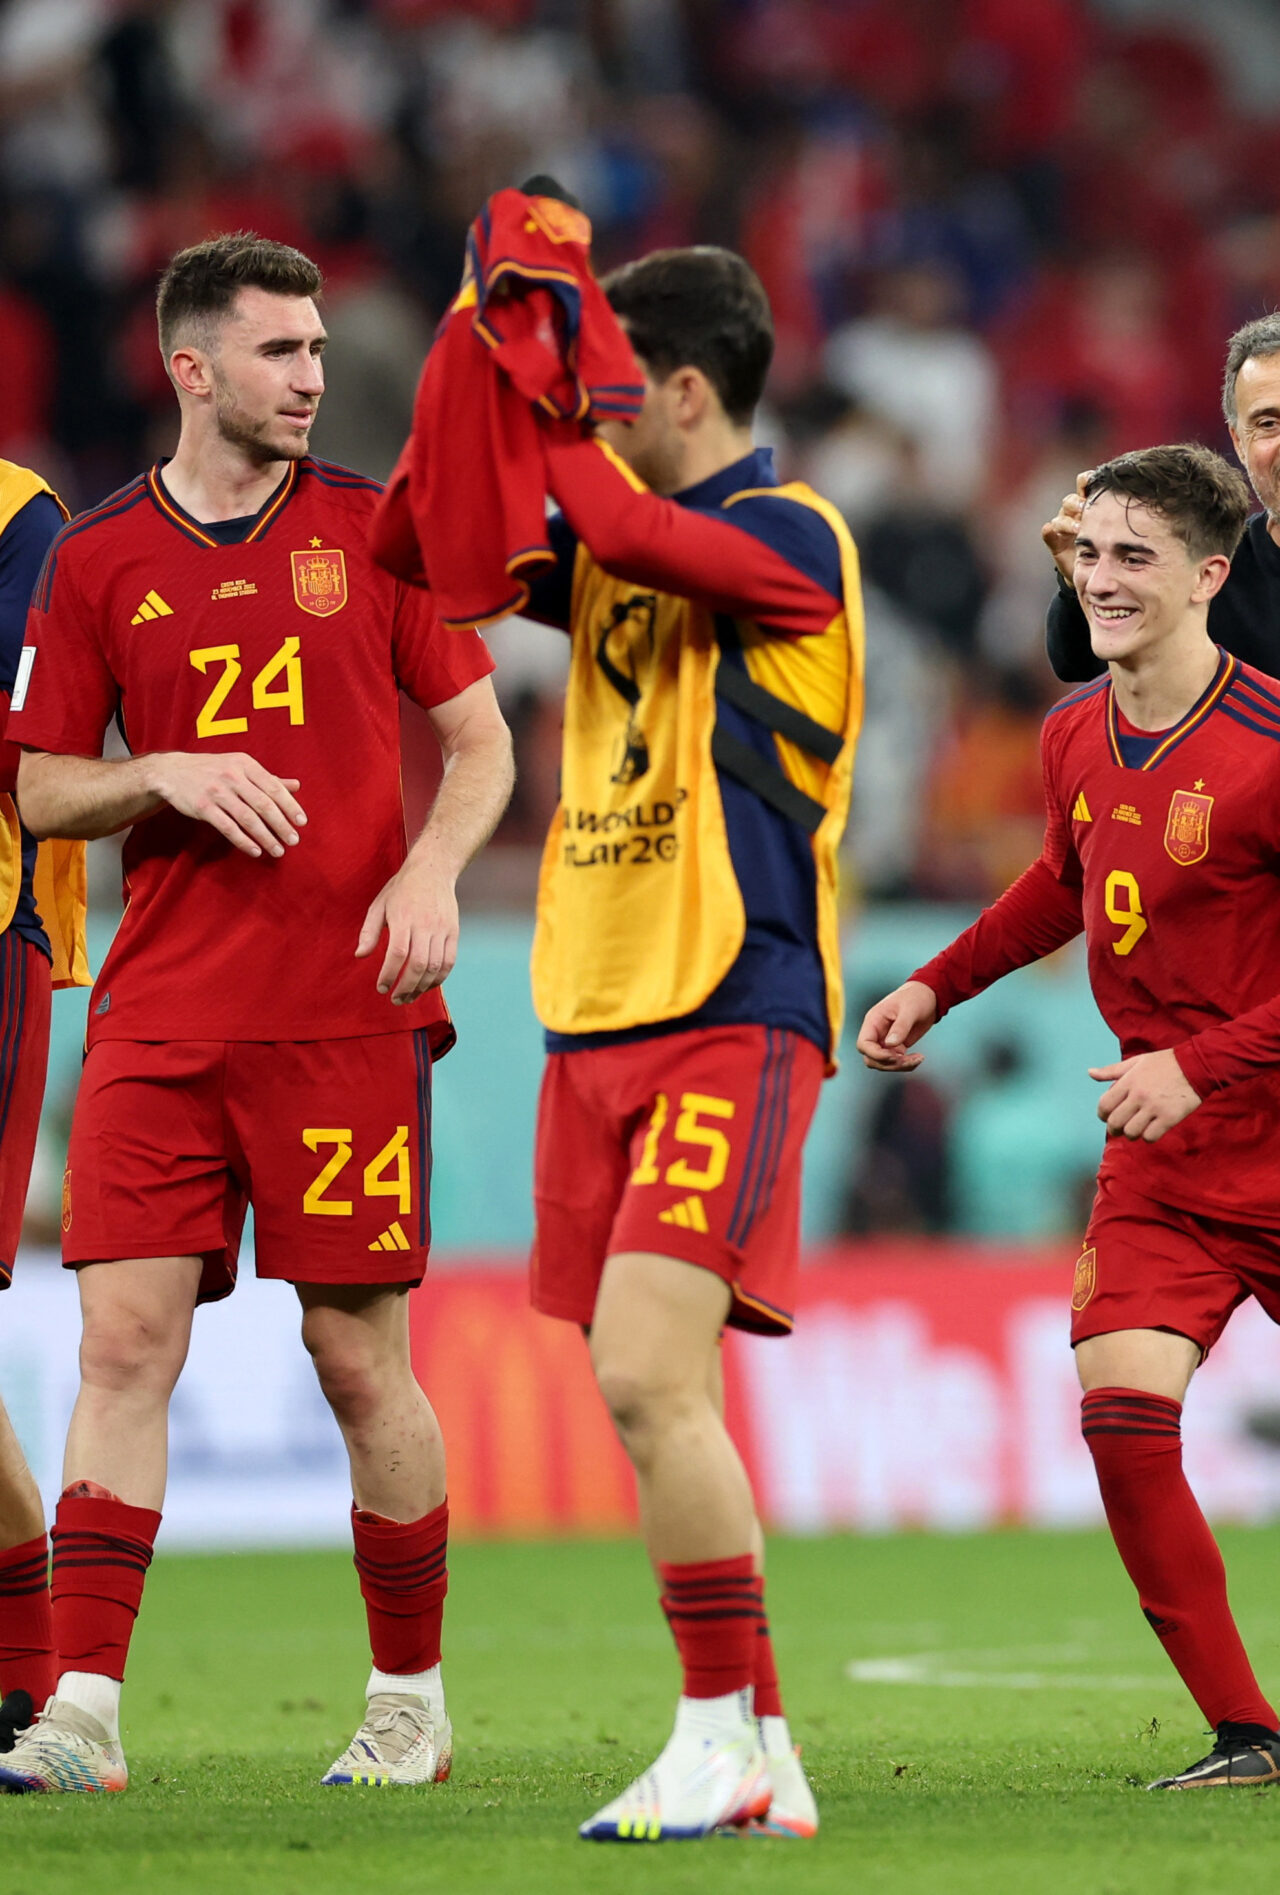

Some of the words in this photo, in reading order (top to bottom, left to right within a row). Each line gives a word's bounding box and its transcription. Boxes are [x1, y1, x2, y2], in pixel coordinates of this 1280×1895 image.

[189, 636, 304, 739] 24
[1104, 869, 1148, 956] 9
[302, 1125, 412, 1216] 24
[630, 1093, 736, 1192] 15
